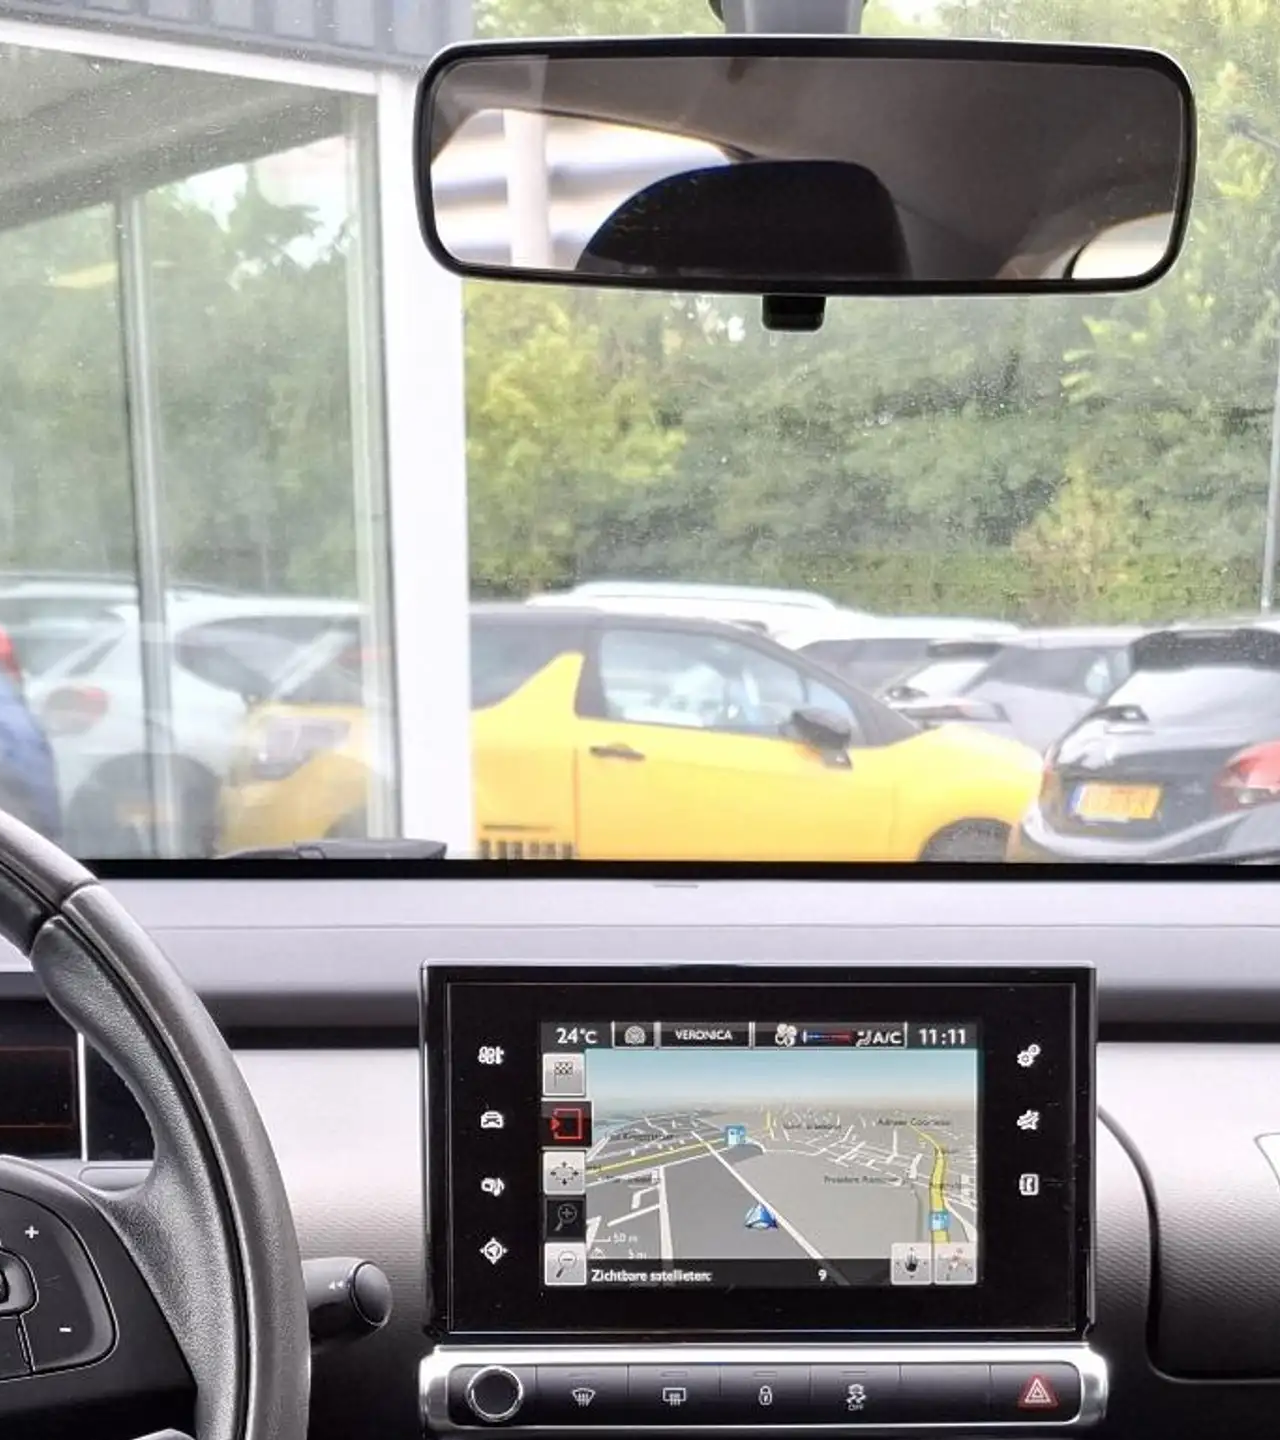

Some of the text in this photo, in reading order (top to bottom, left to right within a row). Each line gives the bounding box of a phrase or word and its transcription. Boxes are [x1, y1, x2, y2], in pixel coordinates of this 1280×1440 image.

[675, 1028, 733, 1041] VERONICA
[872, 1030, 902, 1045] A/C
[919, 1028, 967, 1046] 11:11
[591, 1268, 648, 1282] Zichtbare
